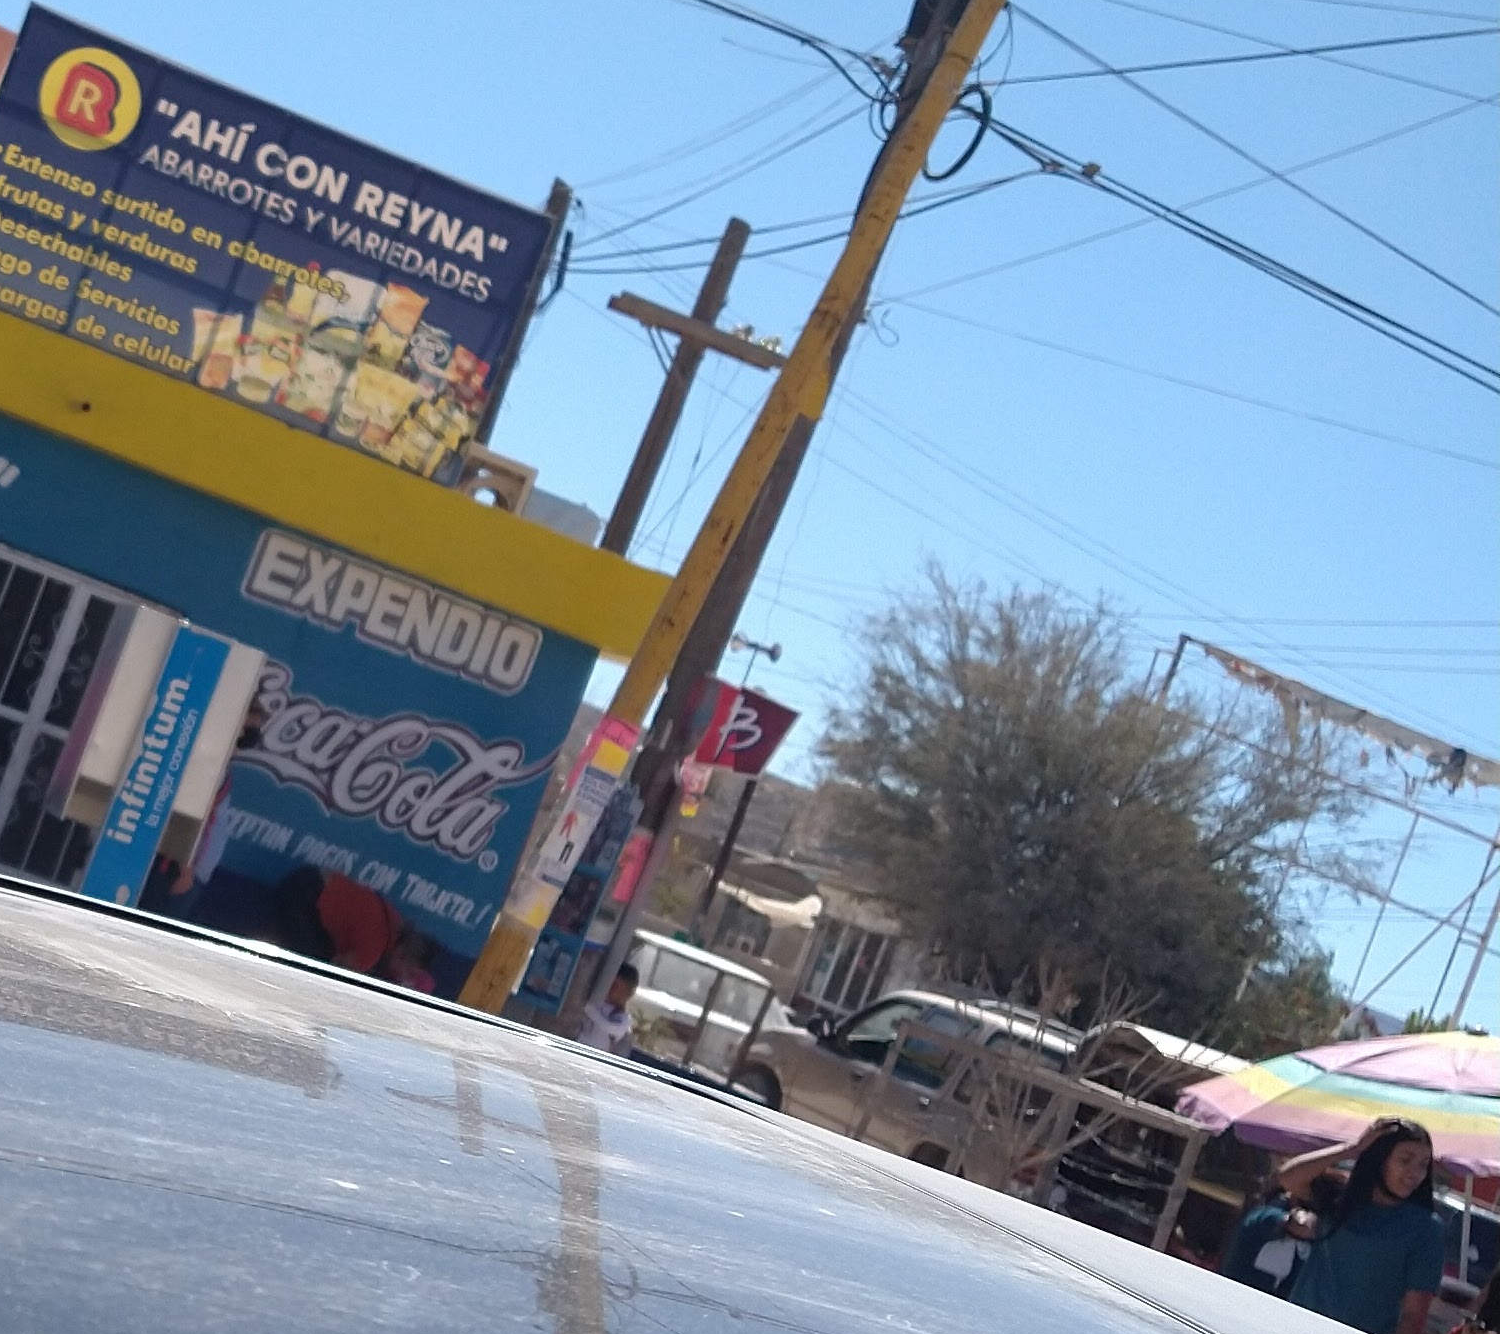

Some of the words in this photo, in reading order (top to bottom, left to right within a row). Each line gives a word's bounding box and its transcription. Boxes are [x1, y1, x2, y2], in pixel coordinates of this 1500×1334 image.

[2, 144, 96, 198] Extenso
[101, 188, 186, 234] surtido
[191, 224, 222, 249] en
[139, 143, 298, 225] ABARROTES
[303, 207, 326, 234] Y
[329, 216, 494, 304] VARIEDADES
[156, 98, 257, 164] "AHÍ
[255, 142, 350, 205] CON
[353, 179, 509, 263] REYNA"
[68, 211, 87, 230] y
[90, 216, 198, 274] verduras
[38, 265, 70, 291] de
[76, 277, 180, 336] Servicios
[75, 314, 107, 340] de
[112, 331, 195, 374] celular
[247, 532, 540, 689] EXPENDIO
[106, 677, 191, 844] infinitum
[154, 771, 176, 813] mejor
[168, 708, 199, 772] conexión
[291, 834, 360, 875] PAGOS
[358, 860, 401, 895] CON
